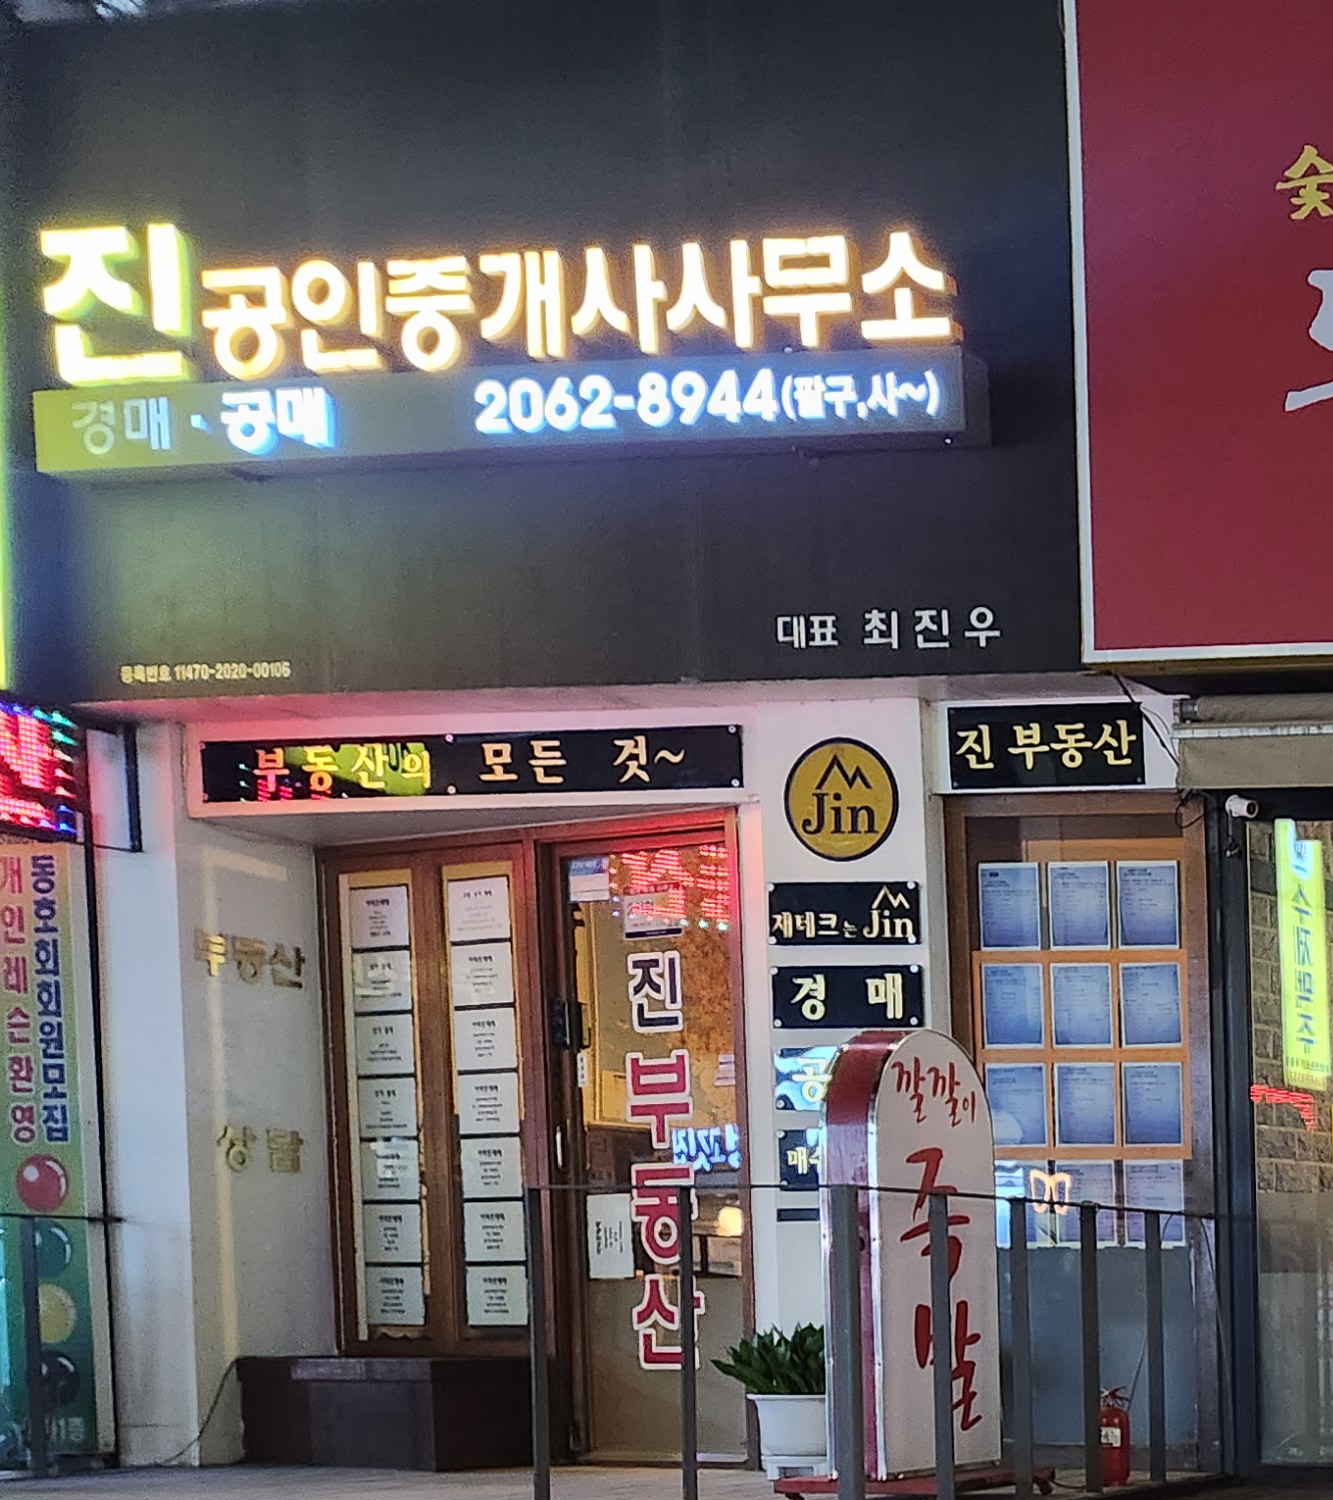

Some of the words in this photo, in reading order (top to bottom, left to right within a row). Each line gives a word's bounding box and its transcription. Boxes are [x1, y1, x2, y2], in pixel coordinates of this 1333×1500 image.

[40, 224, 187, 385] 진
[202, 230, 957, 378] 공인중개사사무소
[71, 393, 173, 455] 경매
[219, 386, 334, 450] 공매
[776, 613, 840, 650] 대표
[252, 740, 433, 791] 부동산의
[479, 739, 568, 784] 모든
[956, 722, 995, 769] 진
[1006, 718, 1138, 770] 부동산
[801, 792, 879, 837] Jin
[862, 908, 915, 941] Jin
[627, 951, 684, 1035] 진
